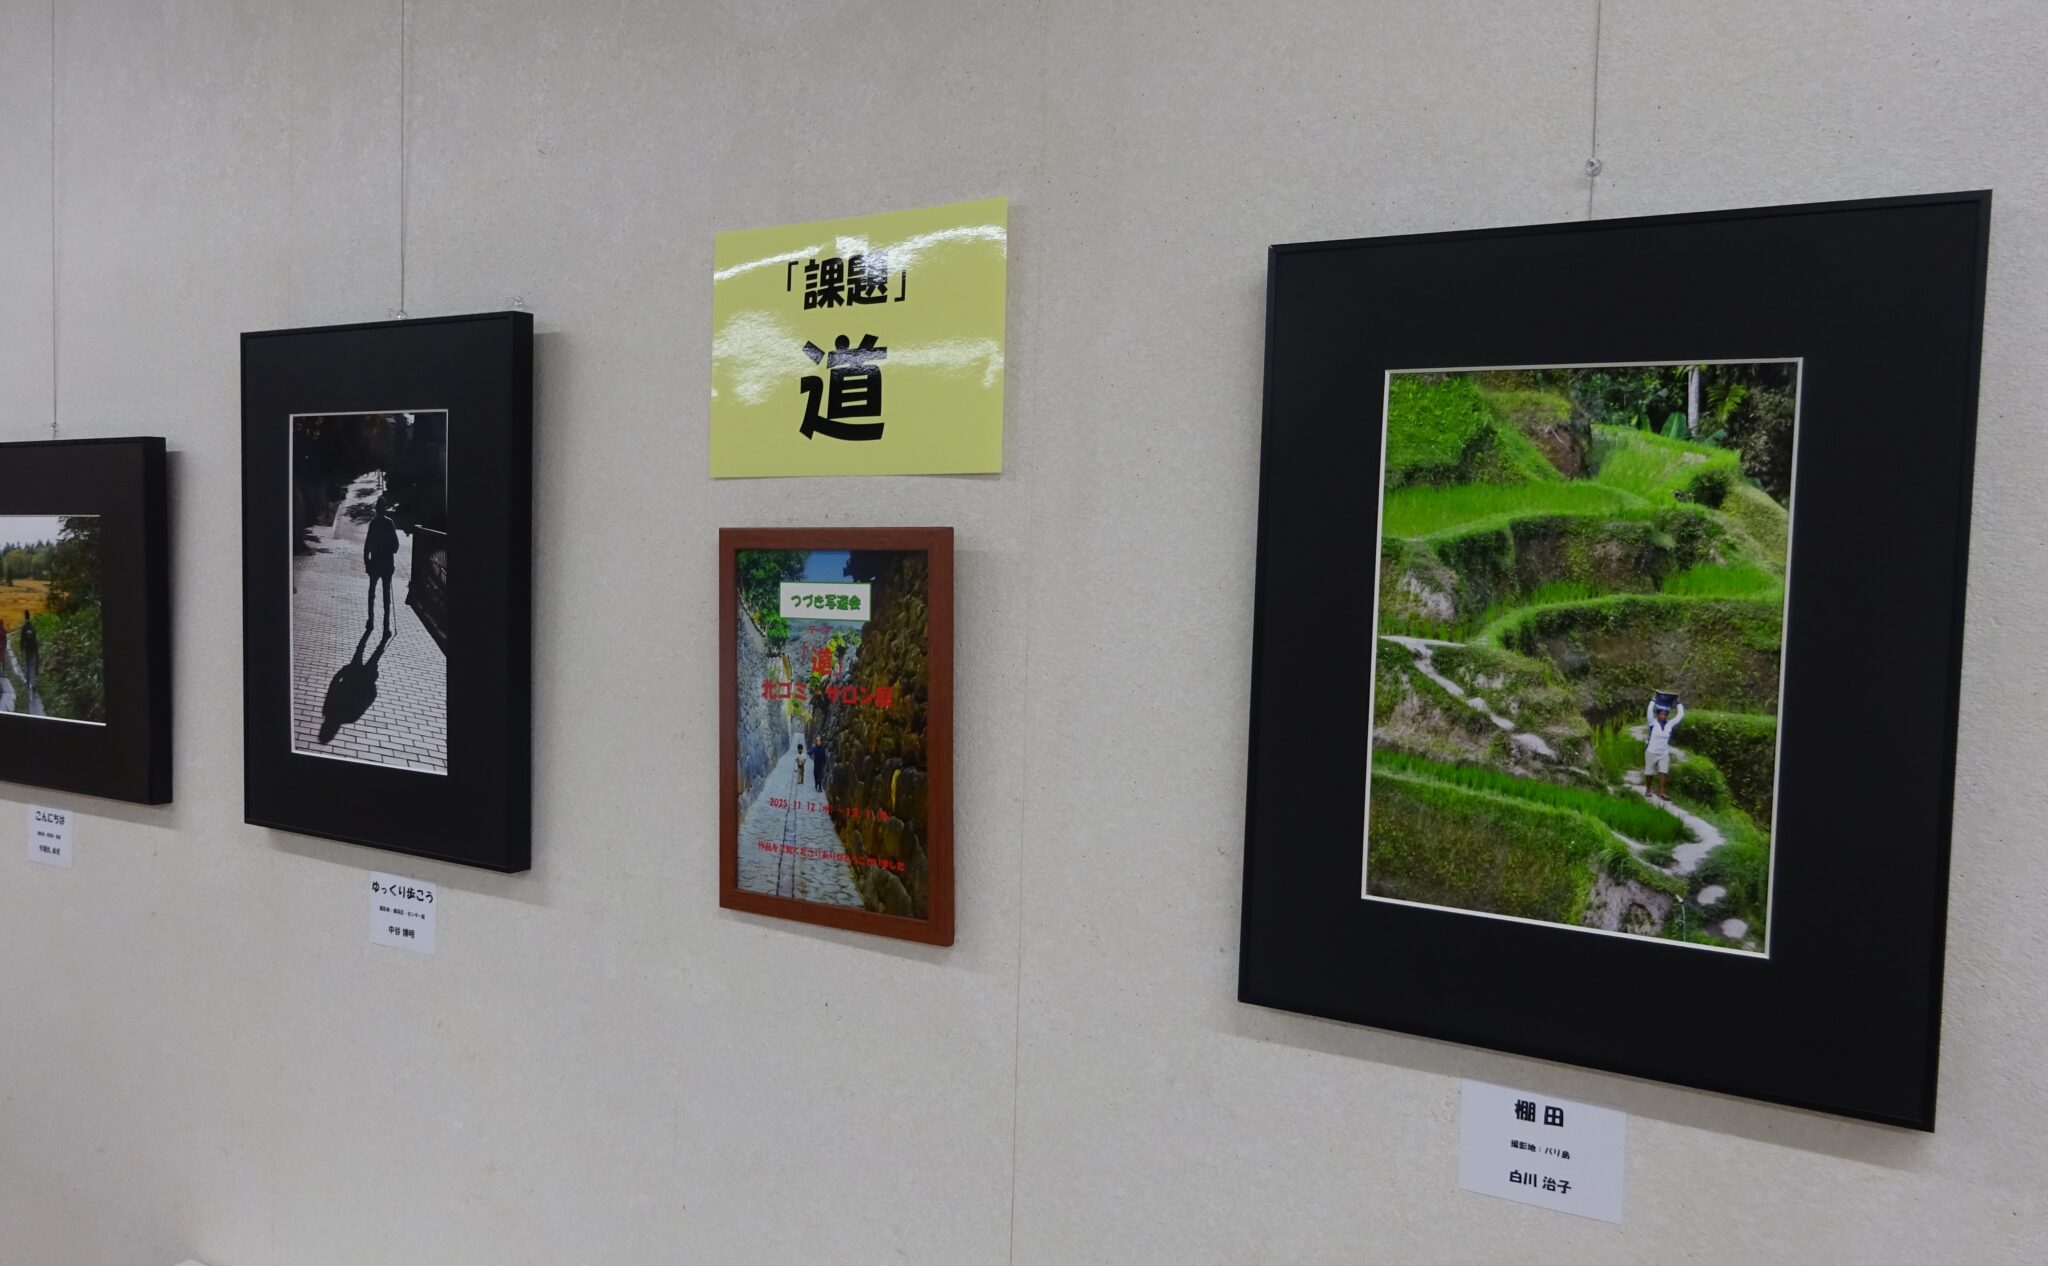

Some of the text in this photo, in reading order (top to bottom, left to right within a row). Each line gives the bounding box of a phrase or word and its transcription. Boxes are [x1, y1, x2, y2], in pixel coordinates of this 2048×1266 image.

[787, 252, 907, 310] 「課題」
[799, 333, 888, 441] 道
[35, 811, 65, 826] こんにちは
[371, 881, 434, 904] ゆっくり歩こう
